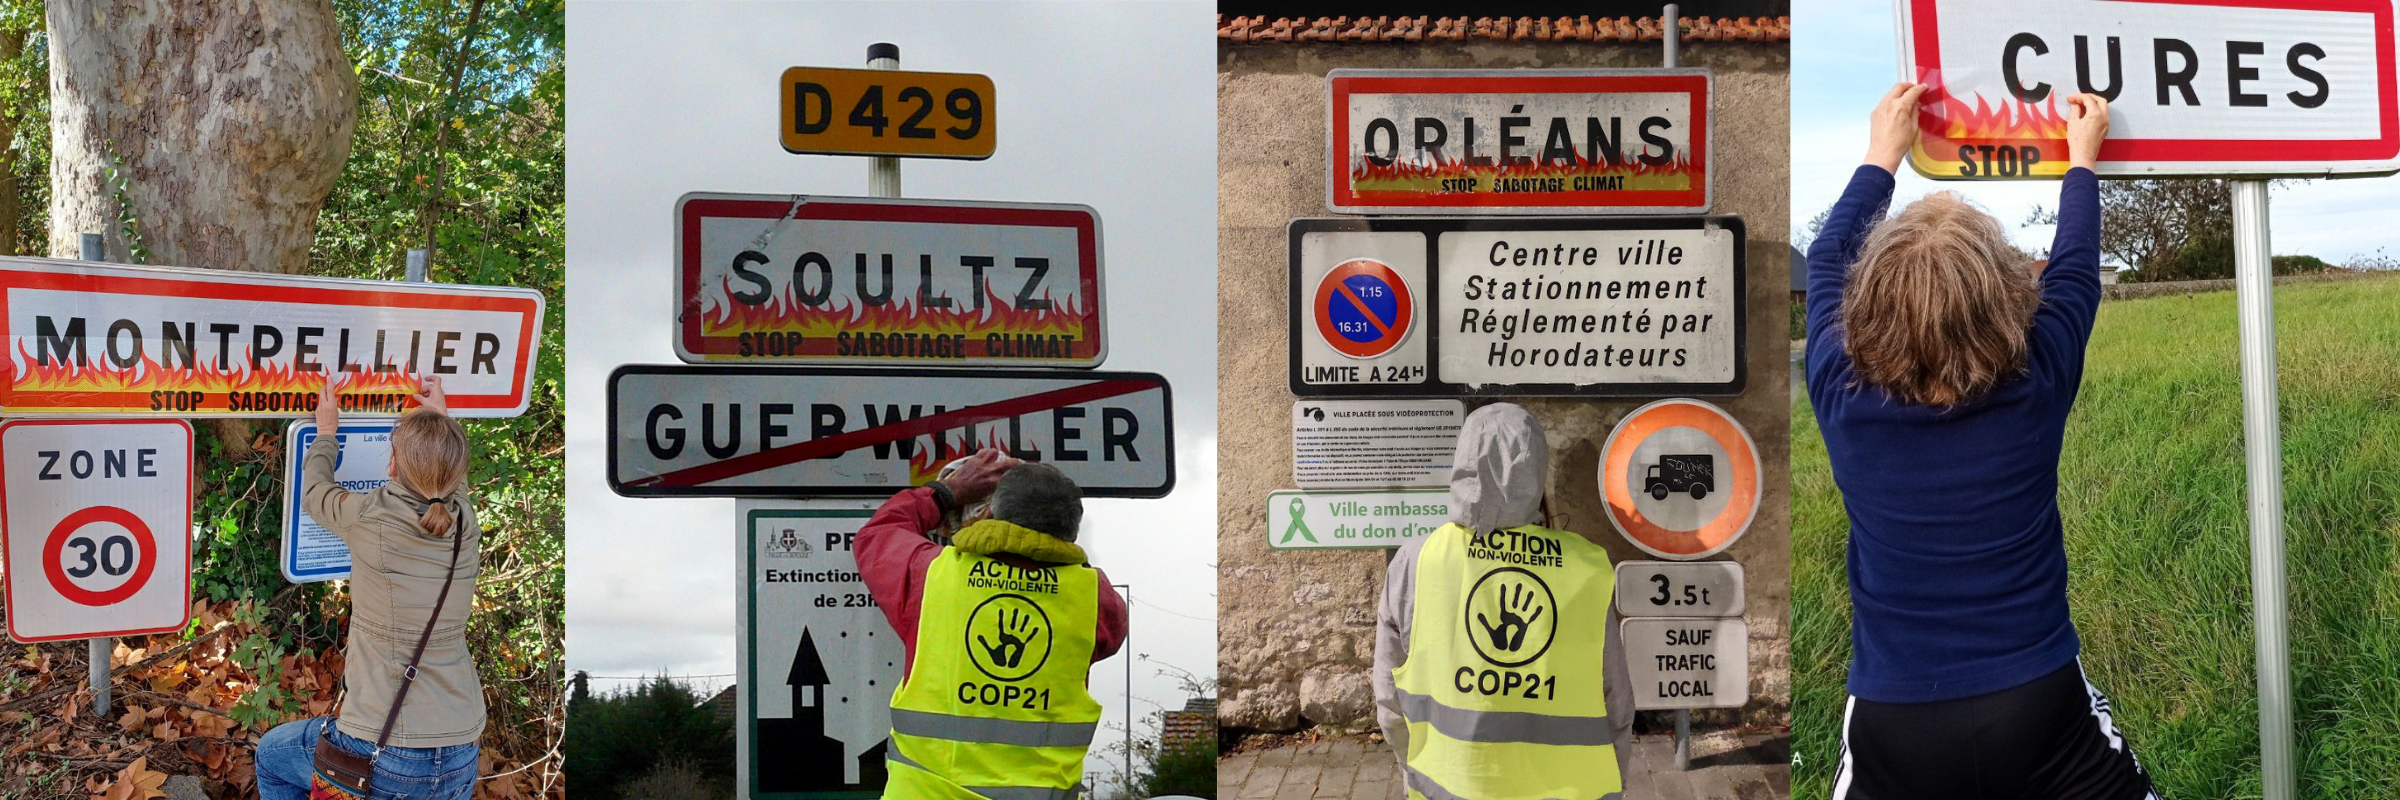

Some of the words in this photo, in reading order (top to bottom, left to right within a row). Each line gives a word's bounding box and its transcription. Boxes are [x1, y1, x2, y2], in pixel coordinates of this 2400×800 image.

[2002, 32, 2329, 108] CURES
[794, 82, 832, 135] D
[848, 85, 983, 140] 429
[1363, 104, 1674, 167] ORLÉANS
[1959, 145, 2041, 177] STOP
[1441, 178, 1478, 193] STOP
[1493, 177, 1565, 193] SABOTAGE
[1573, 175, 1625, 191] CLIMAT
[1489, 240, 1598, 267] Centre
[1618, 239, 1684, 266] ville
[731, 250, 1052, 310] SOULTZ
[1360, 286, 1383, 298] 1.15
[1464, 274, 1708, 301] Stationnement
[1338, 321, 1368, 333] 16.31
[1460, 308, 1651, 341] Réglementé
[1660, 313, 1713, 340] par
[35, 315, 502, 376] MONTPELLIER
[738, 331, 804, 358] STOP
[836, 331, 966, 360] SABOTAGE
[985, 332, 1075, 360] CLIMAT
[1487, 341, 1688, 368] Horodateurs
[1305, 366, 1359, 383] LIMITE
[1369, 366, 1382, 383] A
[150, 389, 205, 412] STOP
[228, 391, 319, 412] SABOTAG
[340, 393, 406, 414] CLIMAT
[1352, 410, 1376, 418] PLACÉE
[1378, 410, 1395, 418] SOUS
[1396, 409, 1455, 418] VIDÉOPROTECTION
[364, 434, 373, 442] La
[375, 434, 387, 442] ville
[645, 402, 1141, 463] GUEBWILLER
[38, 448, 158, 480] ZONE
[335, 479, 391, 490] PROTEC
[1329, 501, 1368, 517] Ville
[1373, 501, 1448, 516] ambassa
[1334, 523, 1356, 539] du
[1362, 523, 1396, 538] don
[1469, 529, 1562, 556] ACTION
[66, 535, 135, 579] 30
[1468, 547, 1563, 568] NON-VIOLENTE
[766, 569, 863, 583] Extinction
[969, 560, 1058, 583] ACTION
[968, 577, 1058, 594] NON-VIOLENTE
[814, 594, 837, 608] de
[1665, 629, 1711, 646] SAUF
[1655, 654, 1715, 671] TRAFIC
[958, 681, 1050, 711] COP21
[1454, 666, 1556, 701] COP21
[1659, 680, 1713, 697] LOCAL
